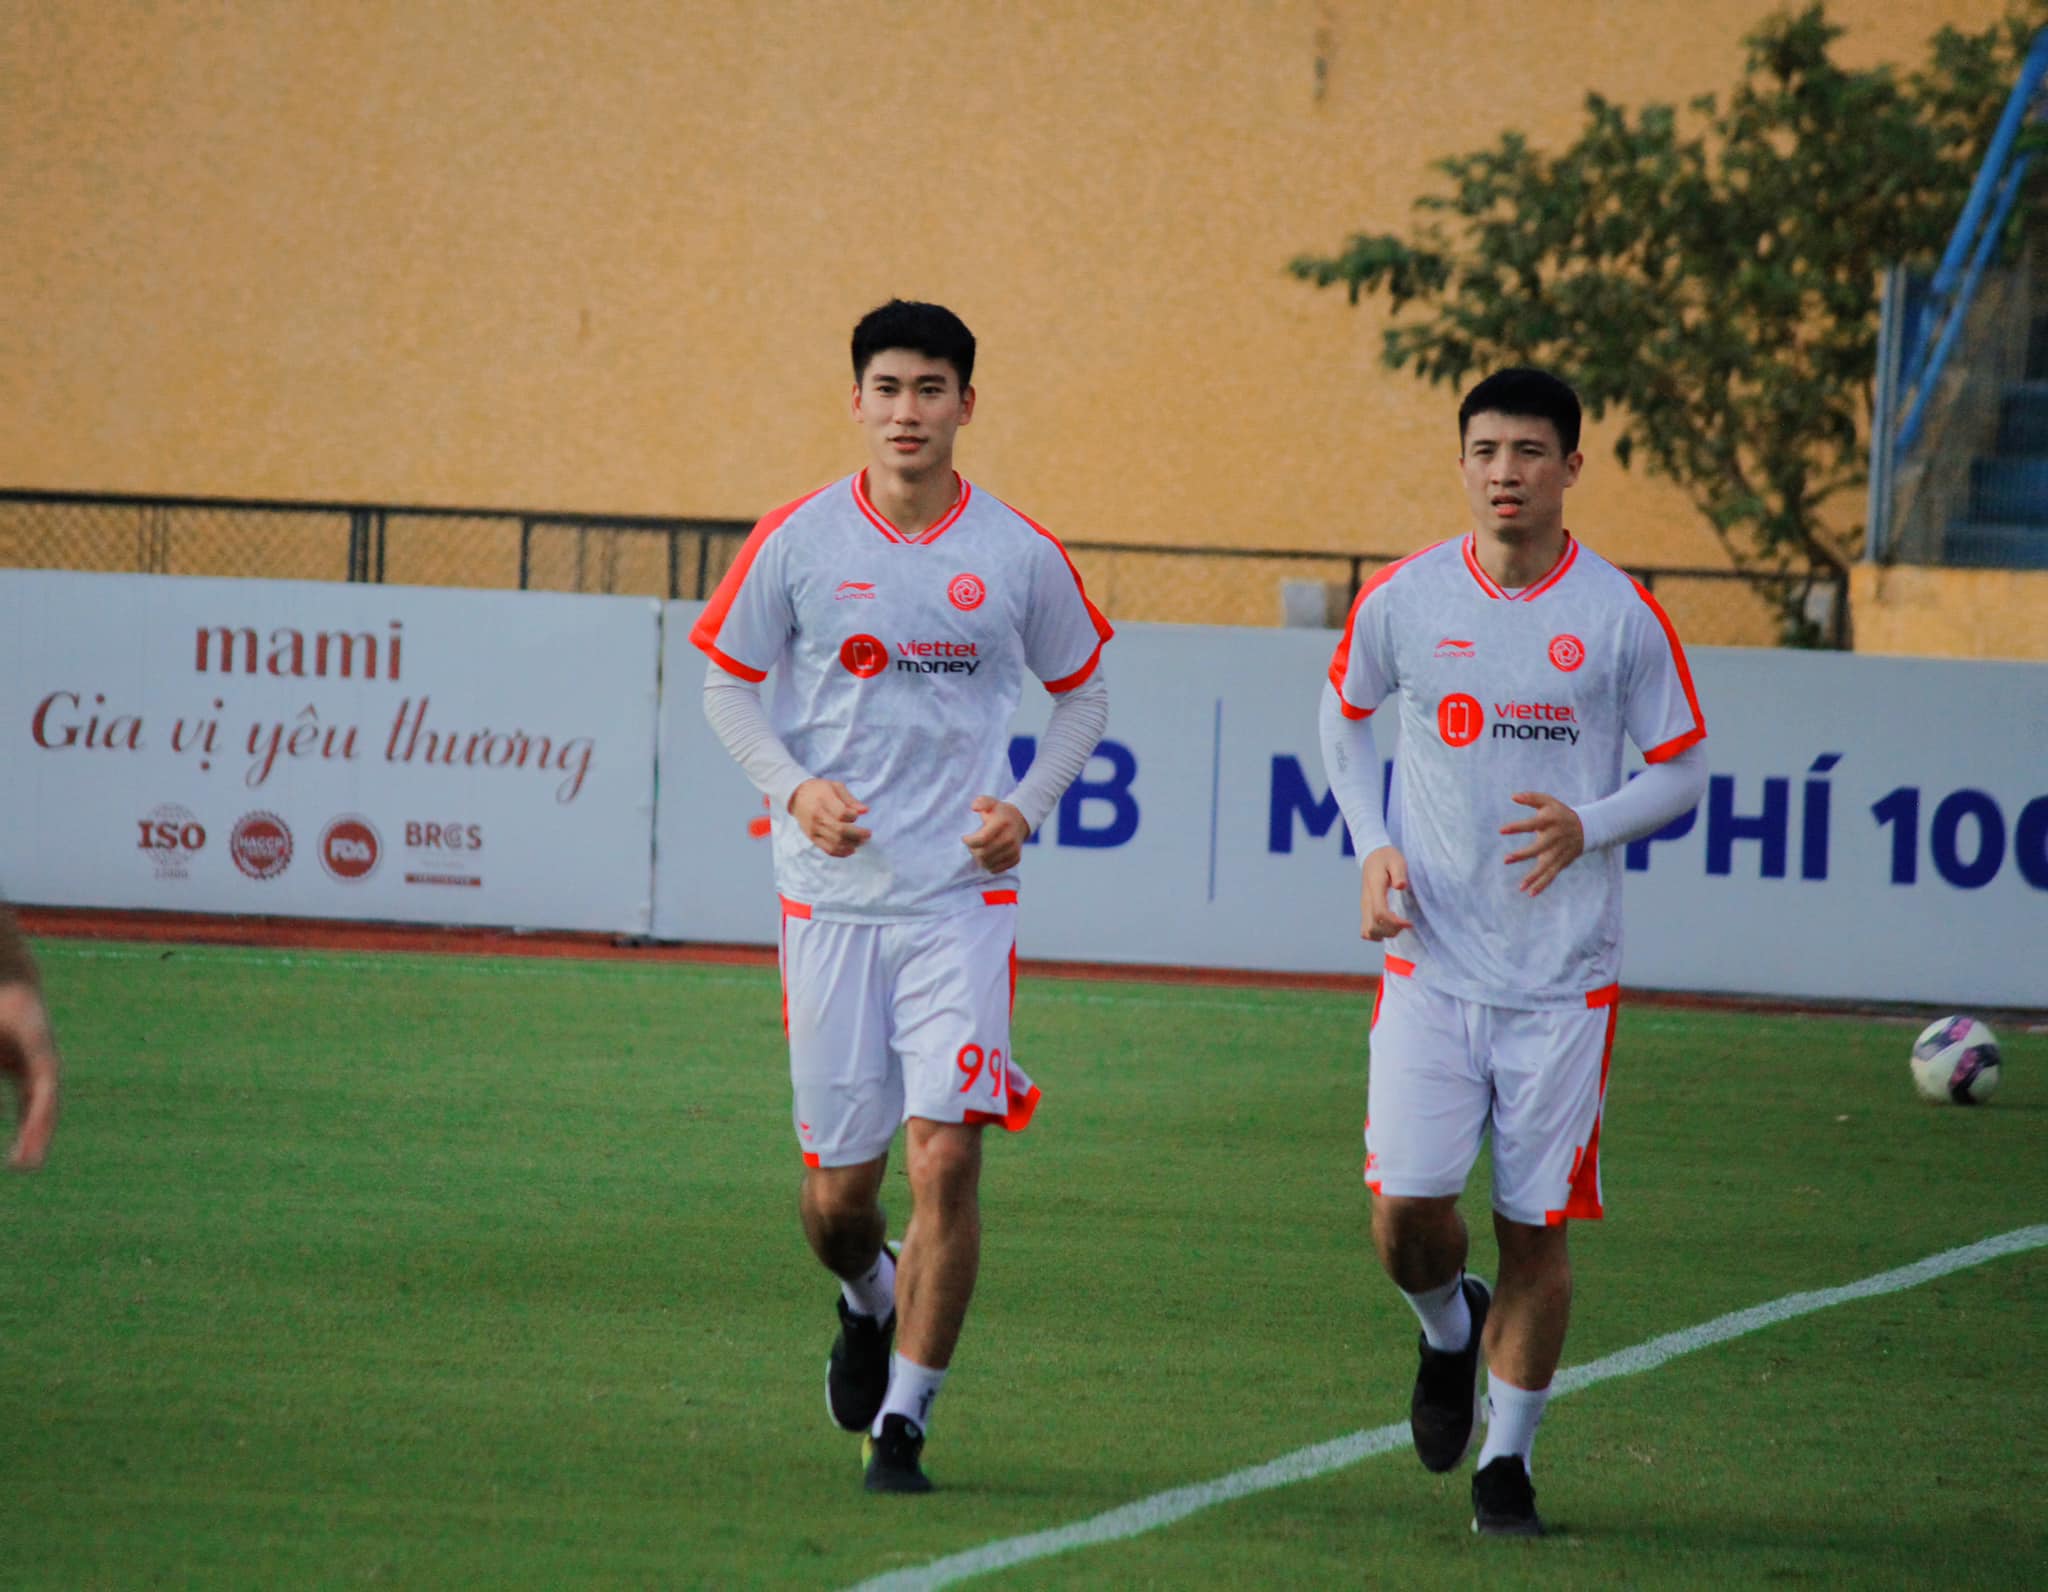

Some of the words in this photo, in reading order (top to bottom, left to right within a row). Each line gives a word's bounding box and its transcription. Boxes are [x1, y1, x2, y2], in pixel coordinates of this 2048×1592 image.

[195, 620, 403, 681] mami
[897, 640, 978, 657] viettel
[897, 659, 981, 676] money
[1494, 701, 1578, 723] viettel
[32, 691, 144, 752] Gia
[171, 697, 224, 771] vị
[246, 703, 359, 787] yêu
[386, 695, 597, 803] thương
[1492, 723, 1580, 746] money
[137, 820, 207, 851] ISO
[956, 1043, 1001, 1097] 99
